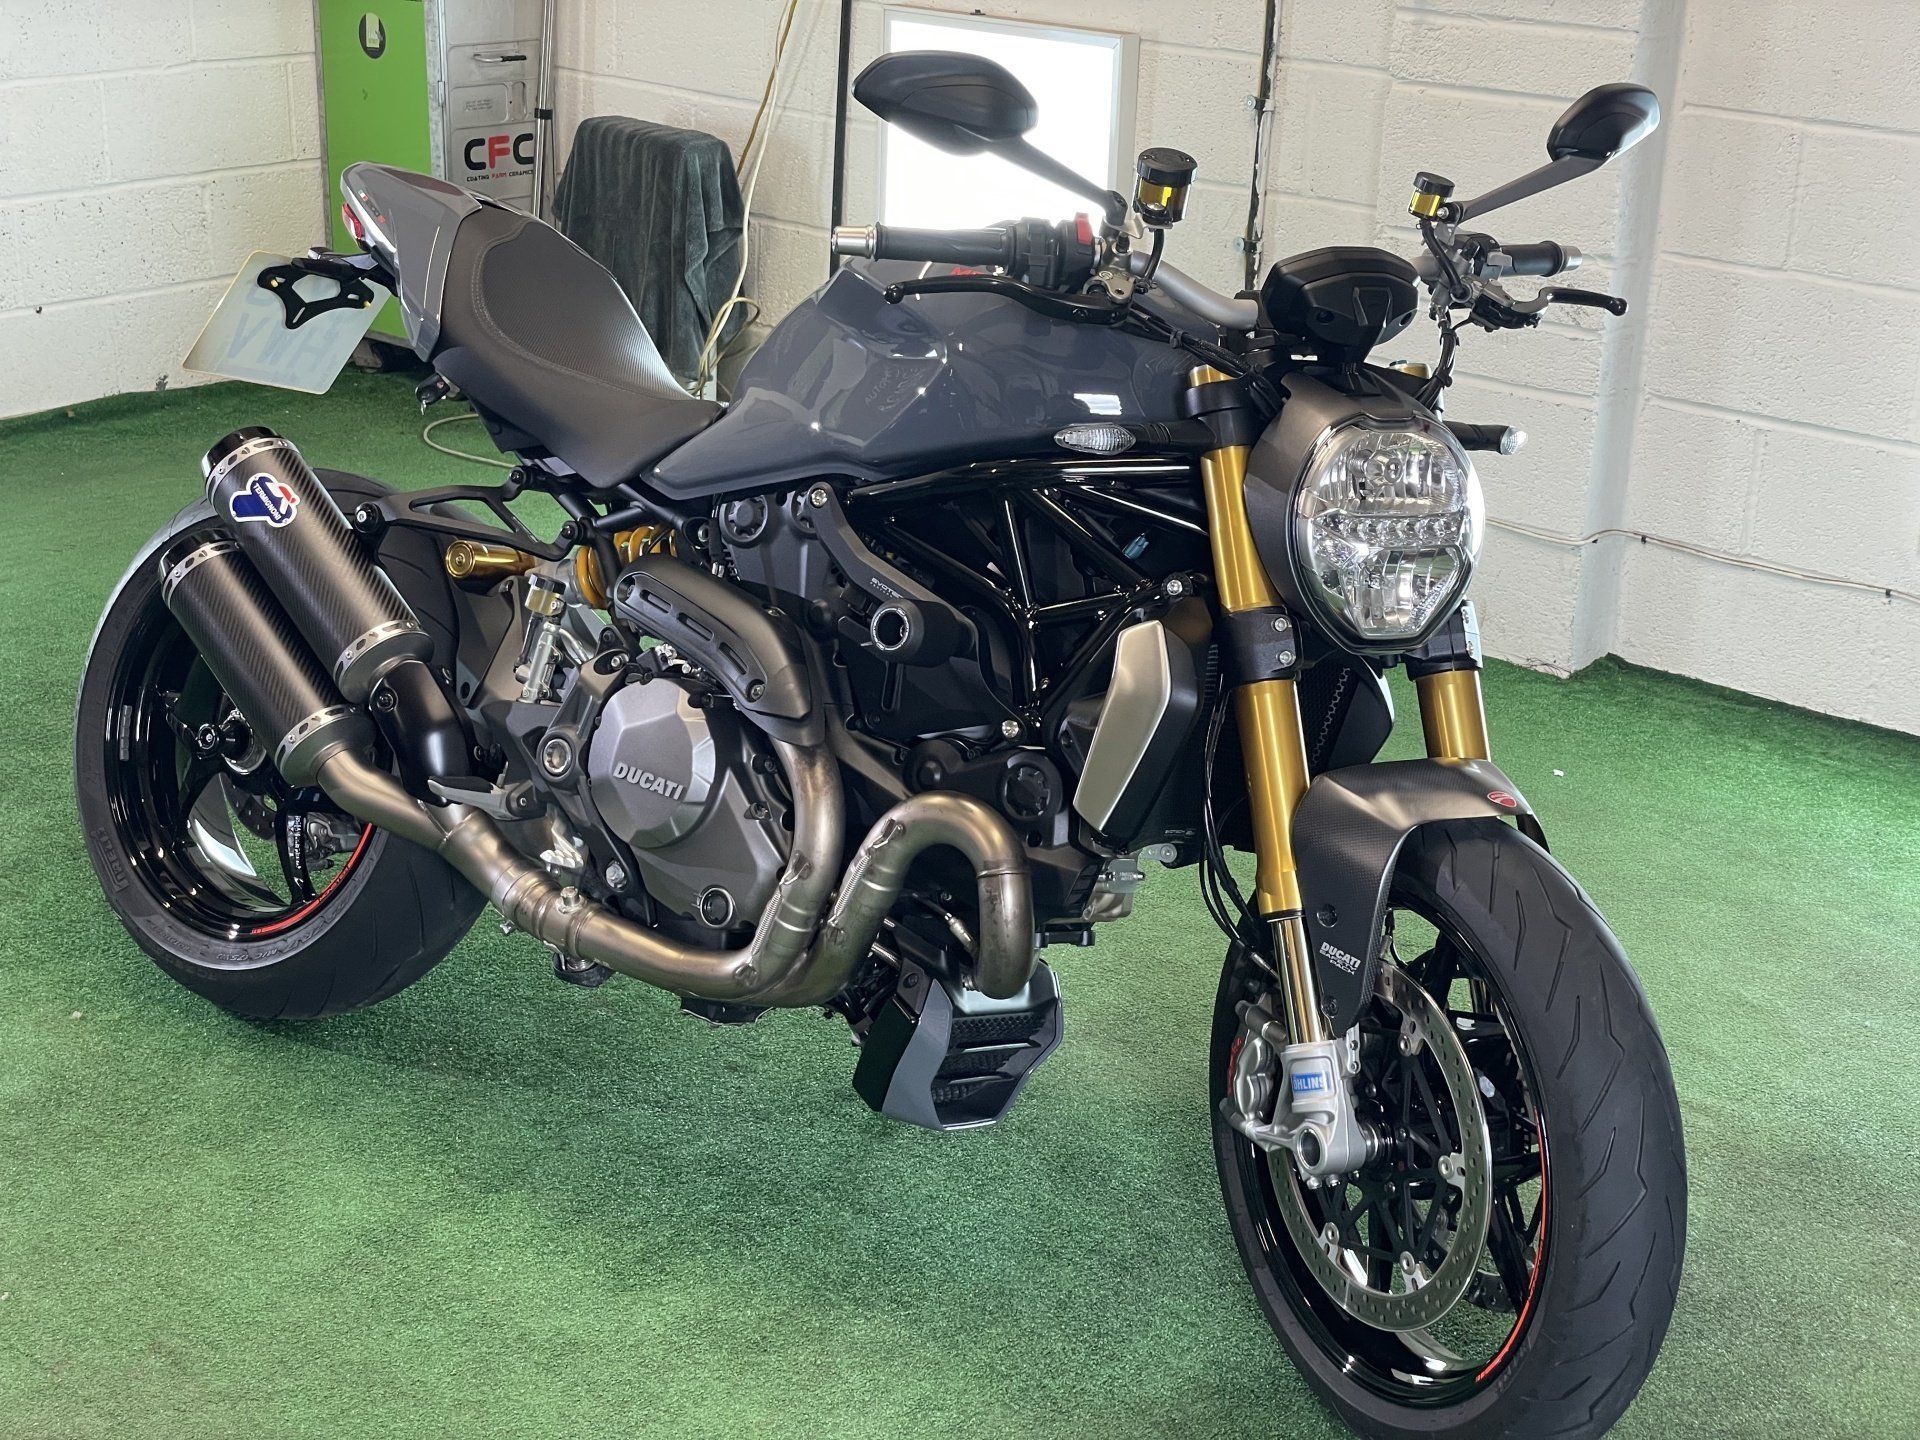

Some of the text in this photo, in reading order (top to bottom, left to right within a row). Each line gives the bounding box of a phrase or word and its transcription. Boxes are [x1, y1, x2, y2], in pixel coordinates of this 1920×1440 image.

[464, 133, 534, 170] CFC
[253, 482, 282, 521] TERMIGNONI
[612, 761, 685, 801] DUCATI
[1320, 941, 1361, 968] DUCATI
